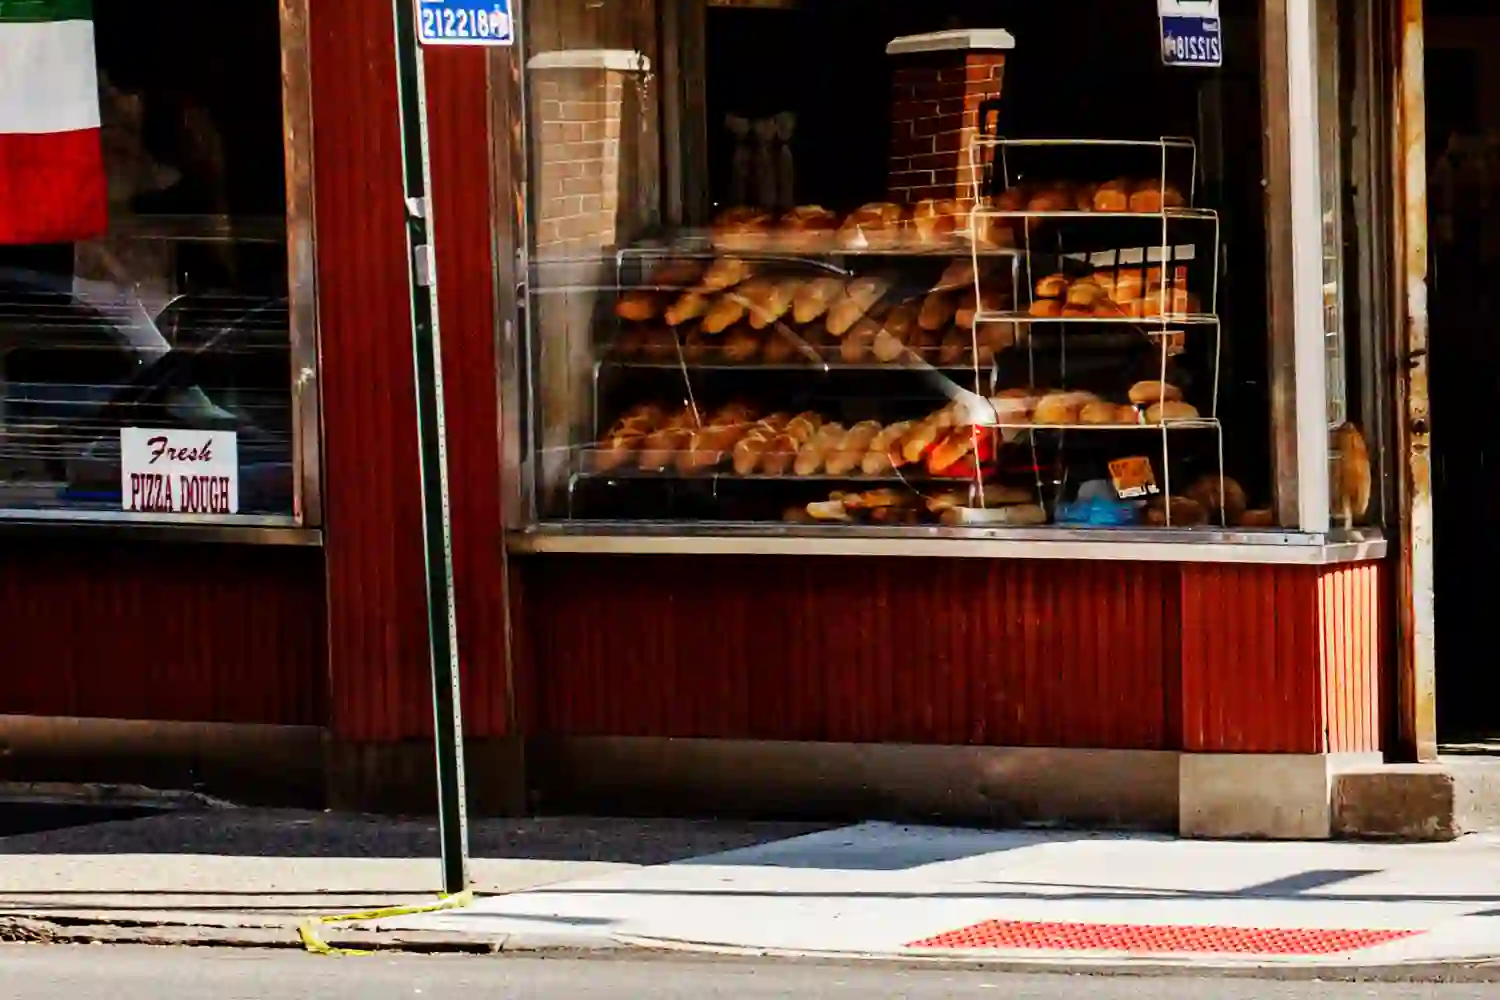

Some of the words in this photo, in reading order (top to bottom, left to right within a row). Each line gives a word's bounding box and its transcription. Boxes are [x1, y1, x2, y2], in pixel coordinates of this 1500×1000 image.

[421, 7, 489, 38] 212218
[147, 435, 213, 464] Fresh
[130, 472, 173, 513] PIZZA
[180, 474, 230, 514] DOUGH
